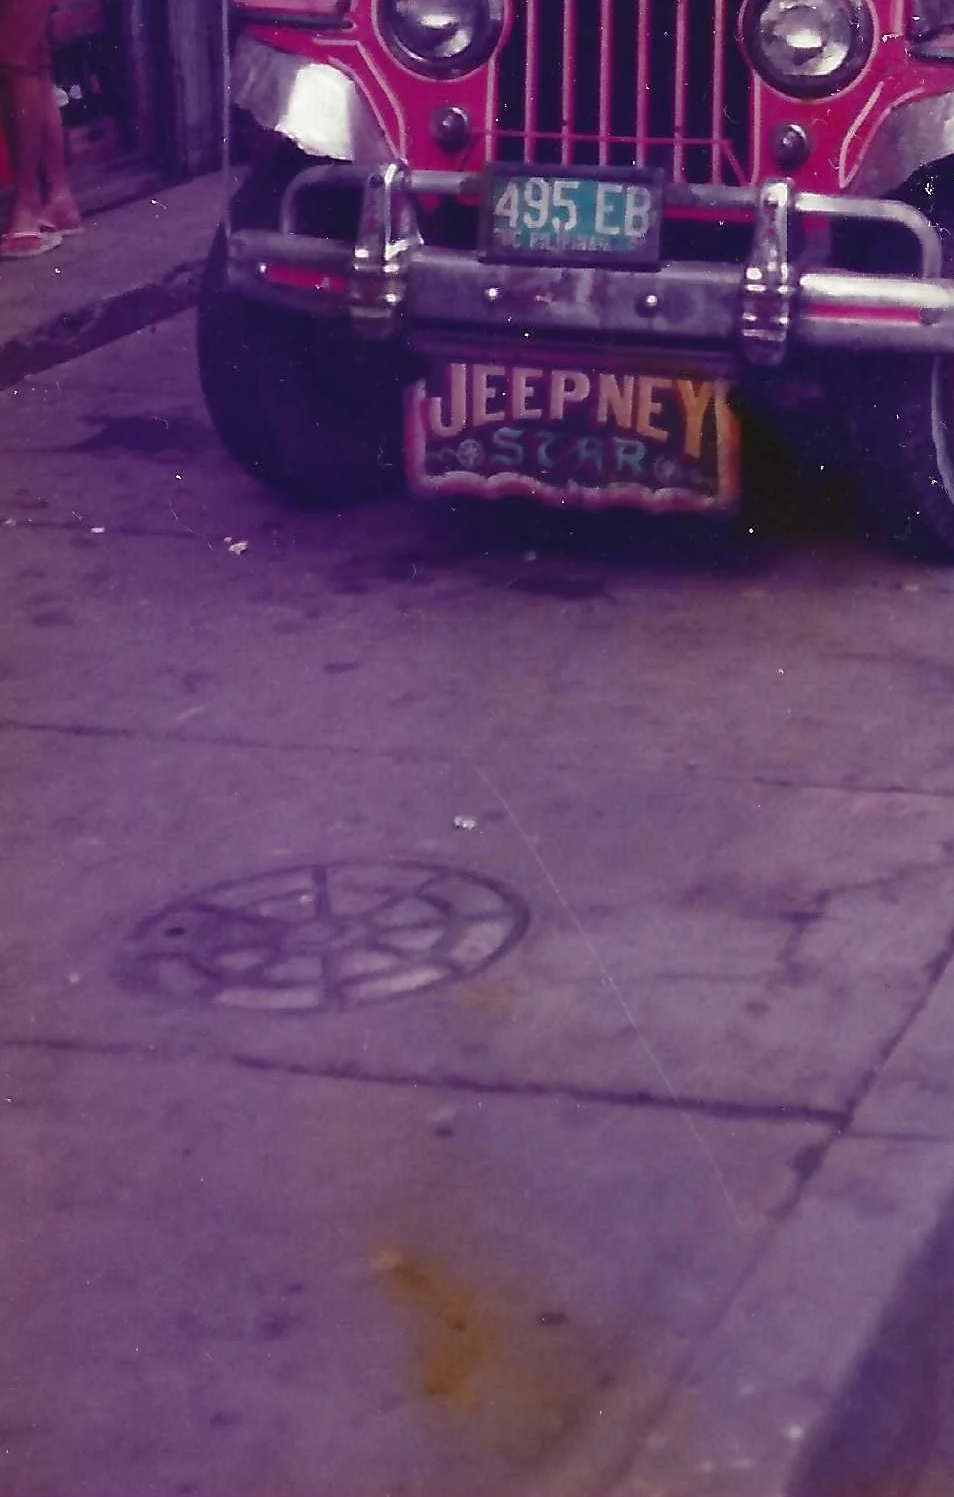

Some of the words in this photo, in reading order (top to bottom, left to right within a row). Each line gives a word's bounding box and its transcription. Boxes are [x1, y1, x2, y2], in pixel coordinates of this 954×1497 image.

[493, 177, 580, 232] 495
[595, 184, 651, 239] EB
[429, 362, 714, 459] JEEPNEY
[490, 427, 648, 474] STAR
